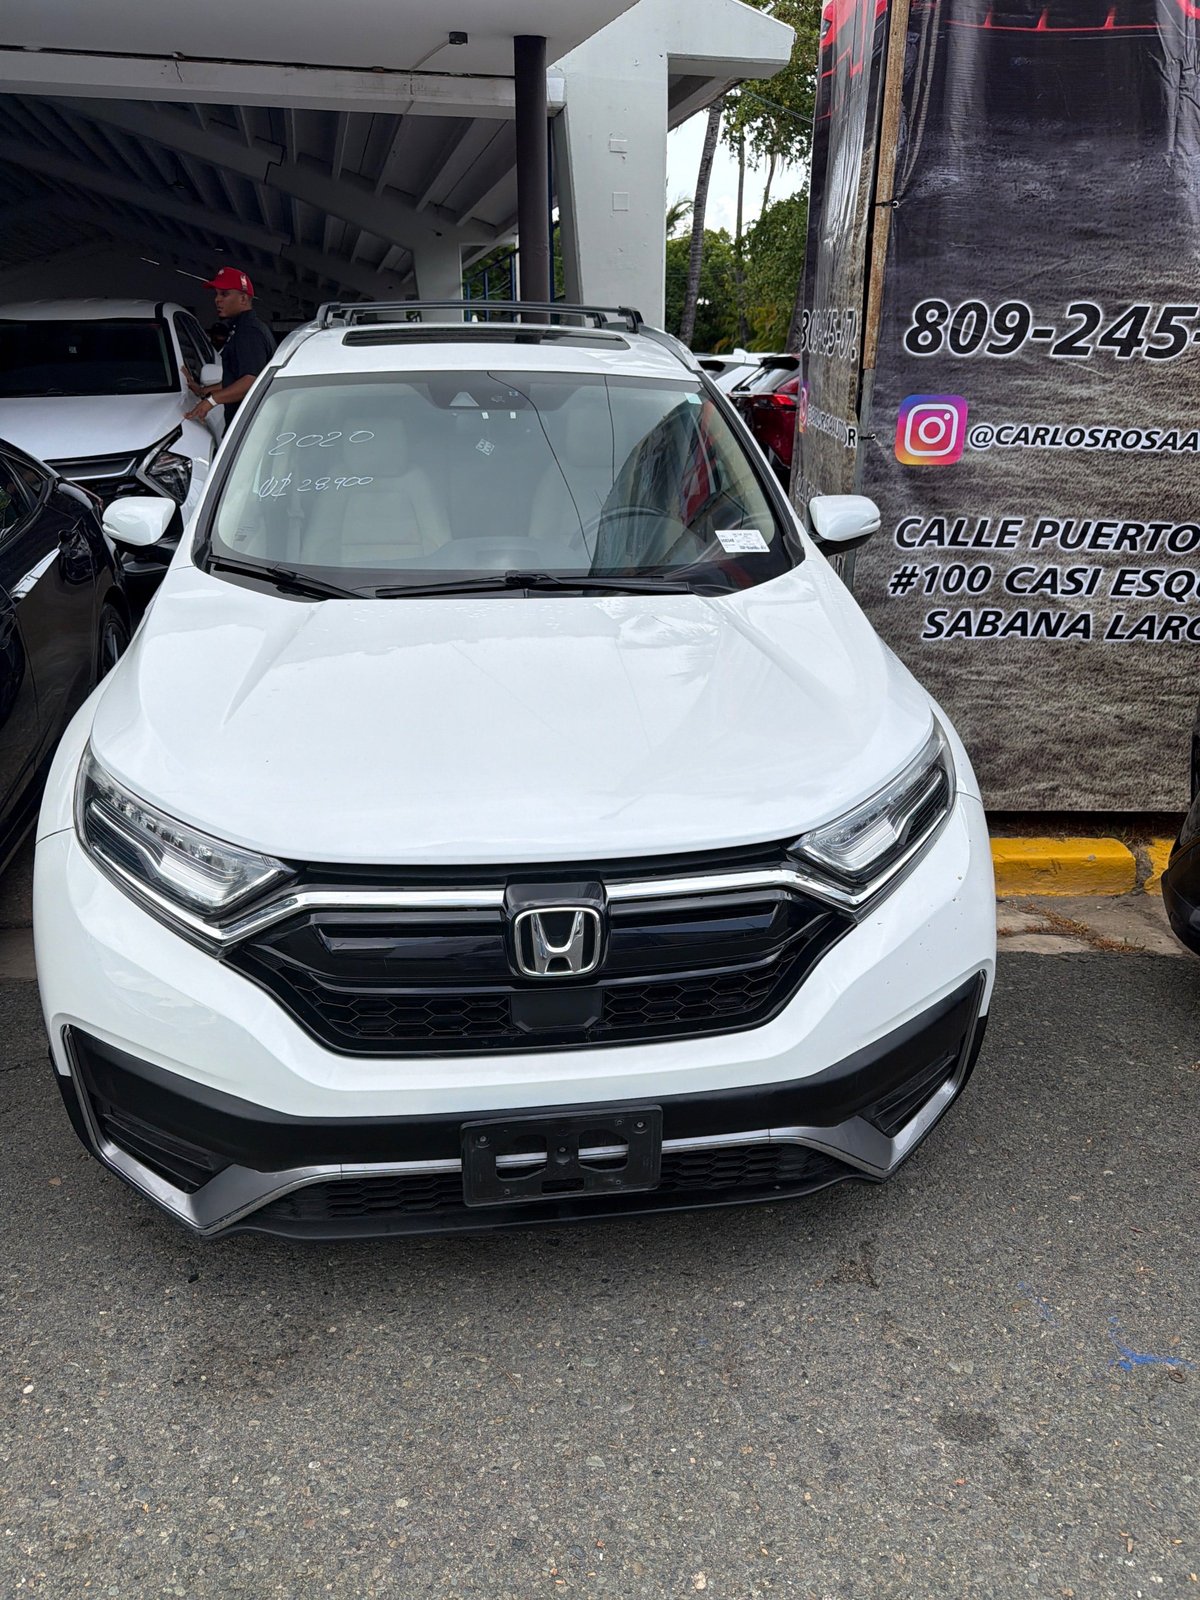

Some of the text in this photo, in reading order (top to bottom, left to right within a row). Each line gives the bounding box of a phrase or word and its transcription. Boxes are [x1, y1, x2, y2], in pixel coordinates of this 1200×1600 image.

[903, 299, 1200, 360] 809-245
[268, 430, 375, 456] 2020
[968, 424, 1200, 452] @CARLOSROSAA
[895, 517, 1200, 553] CALLE PUERTO
[888, 564, 1200, 603] #100 CASI ESQ
[921, 610, 1092, 640] SABANA
